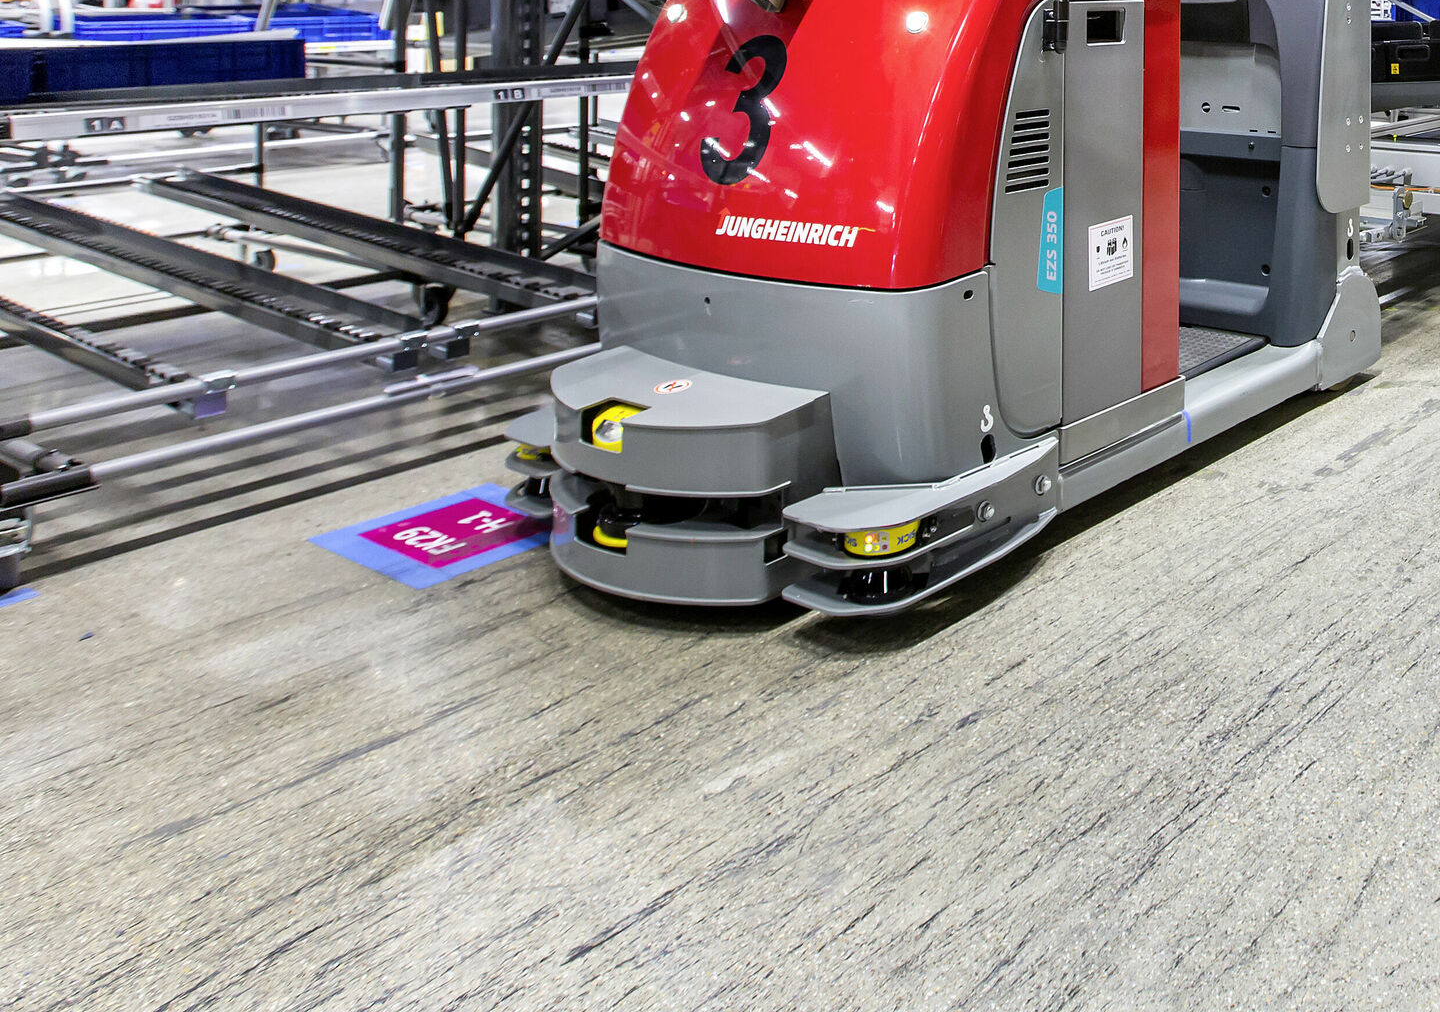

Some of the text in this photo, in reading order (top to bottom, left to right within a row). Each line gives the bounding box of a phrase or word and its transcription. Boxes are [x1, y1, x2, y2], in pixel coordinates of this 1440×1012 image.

[513, 89, 524, 99] B
[700, 34, 788, 185] 3
[90, 119, 124, 131] 1 A
[715, 215, 859, 248] JUNGHEINRICH
[1046, 210, 1058, 281] EZS 350
[1100, 224, 1125, 237] CAUTION!
[392, 525, 468, 556] FK29
